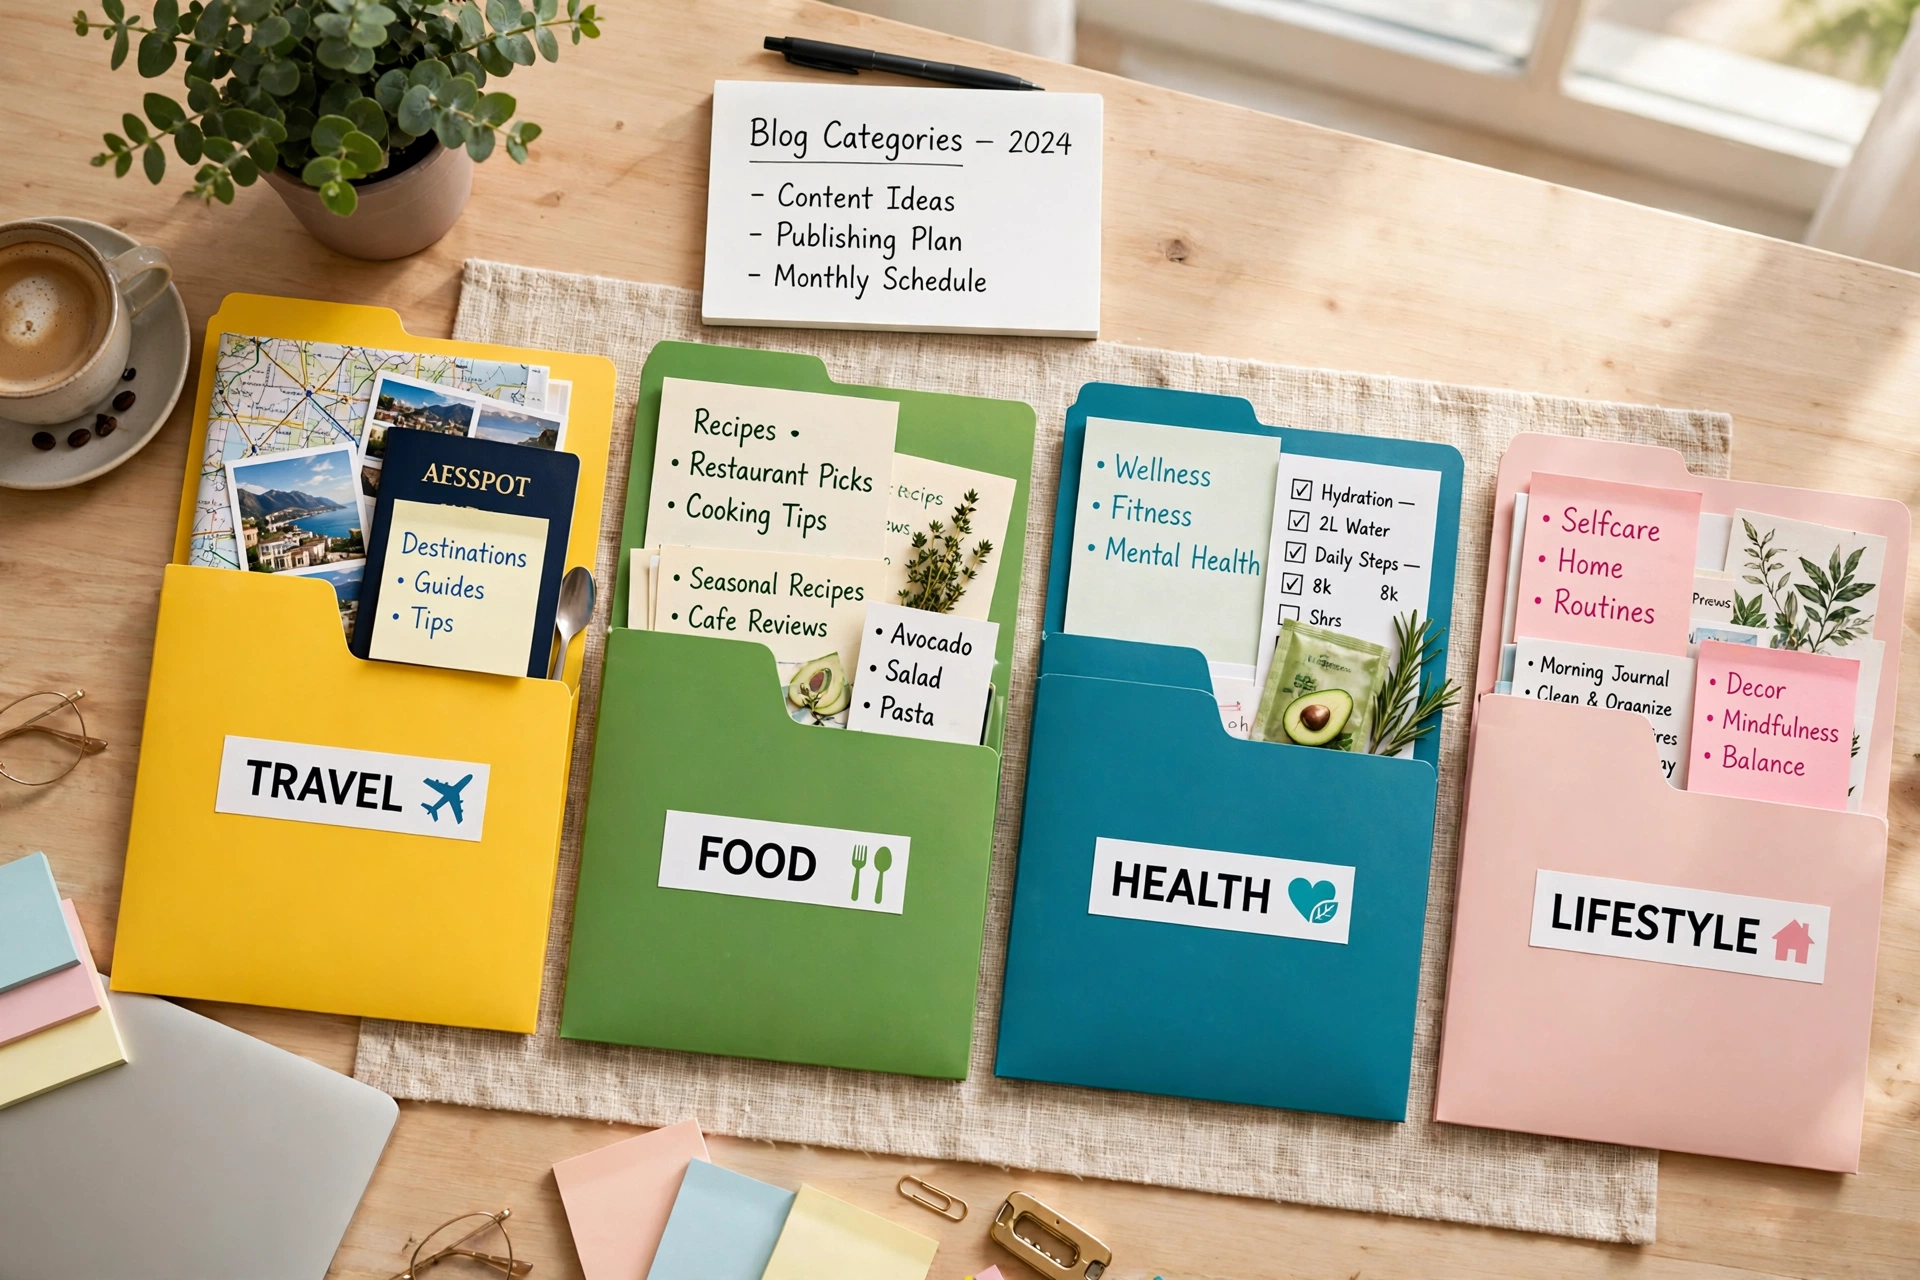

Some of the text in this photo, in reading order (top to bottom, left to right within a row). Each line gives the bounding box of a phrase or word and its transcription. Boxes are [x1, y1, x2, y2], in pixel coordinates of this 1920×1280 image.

[749, 117, 808, 159] Blog
[822, 119, 963, 161] Categories
[1008, 129, 1072, 156] 2024
[778, 182, 955, 212] Content Ideas
[777, 220, 962, 261] Publishing Plan
[774, 263, 987, 301] Monthly Schedule
[694, 407, 776, 448] Recipes
[690, 450, 873, 493] Restaurant Picks
[1116, 453, 1211, 487] Wellness
[1112, 494, 1192, 527] Fitness
[1321, 483, 1393, 509] Hydration
[686, 492, 827, 539] Cooking Tips
[1319, 515, 1391, 538] 2L Water
[1561, 506, 1660, 542] Selfcare
[401, 531, 527, 568] Destinations
[1105, 536, 1260, 576] Mental Health
[1315, 545, 1399, 576] Daily Steps
[1558, 546, 1623, 579] Home
[414, 570, 485, 600] Guides
[689, 566, 864, 609] Seasonal Recipes
[1312, 577, 1399, 602] 8k 8k
[410, 606, 454, 640] Tips
[688, 604, 828, 638] Cafe Reviews
[1554, 587, 1655, 625] Routines
[890, 622, 973, 656] Avocado
[885, 658, 943, 690] Salad
[1540, 655, 1670, 688] Morning Journal
[1726, 671, 1787, 700] Decor
[880, 695, 934, 727] Pasta
[1722, 708, 1839, 743] Mindfulness
[1722, 744, 1805, 777] Balance
[246, 759, 403, 813] TRAVEL
[698, 835, 817, 882] FOOD
[1112, 860, 1271, 914] HEALTH
[1551, 892, 1761, 955] LIFESTYLE
